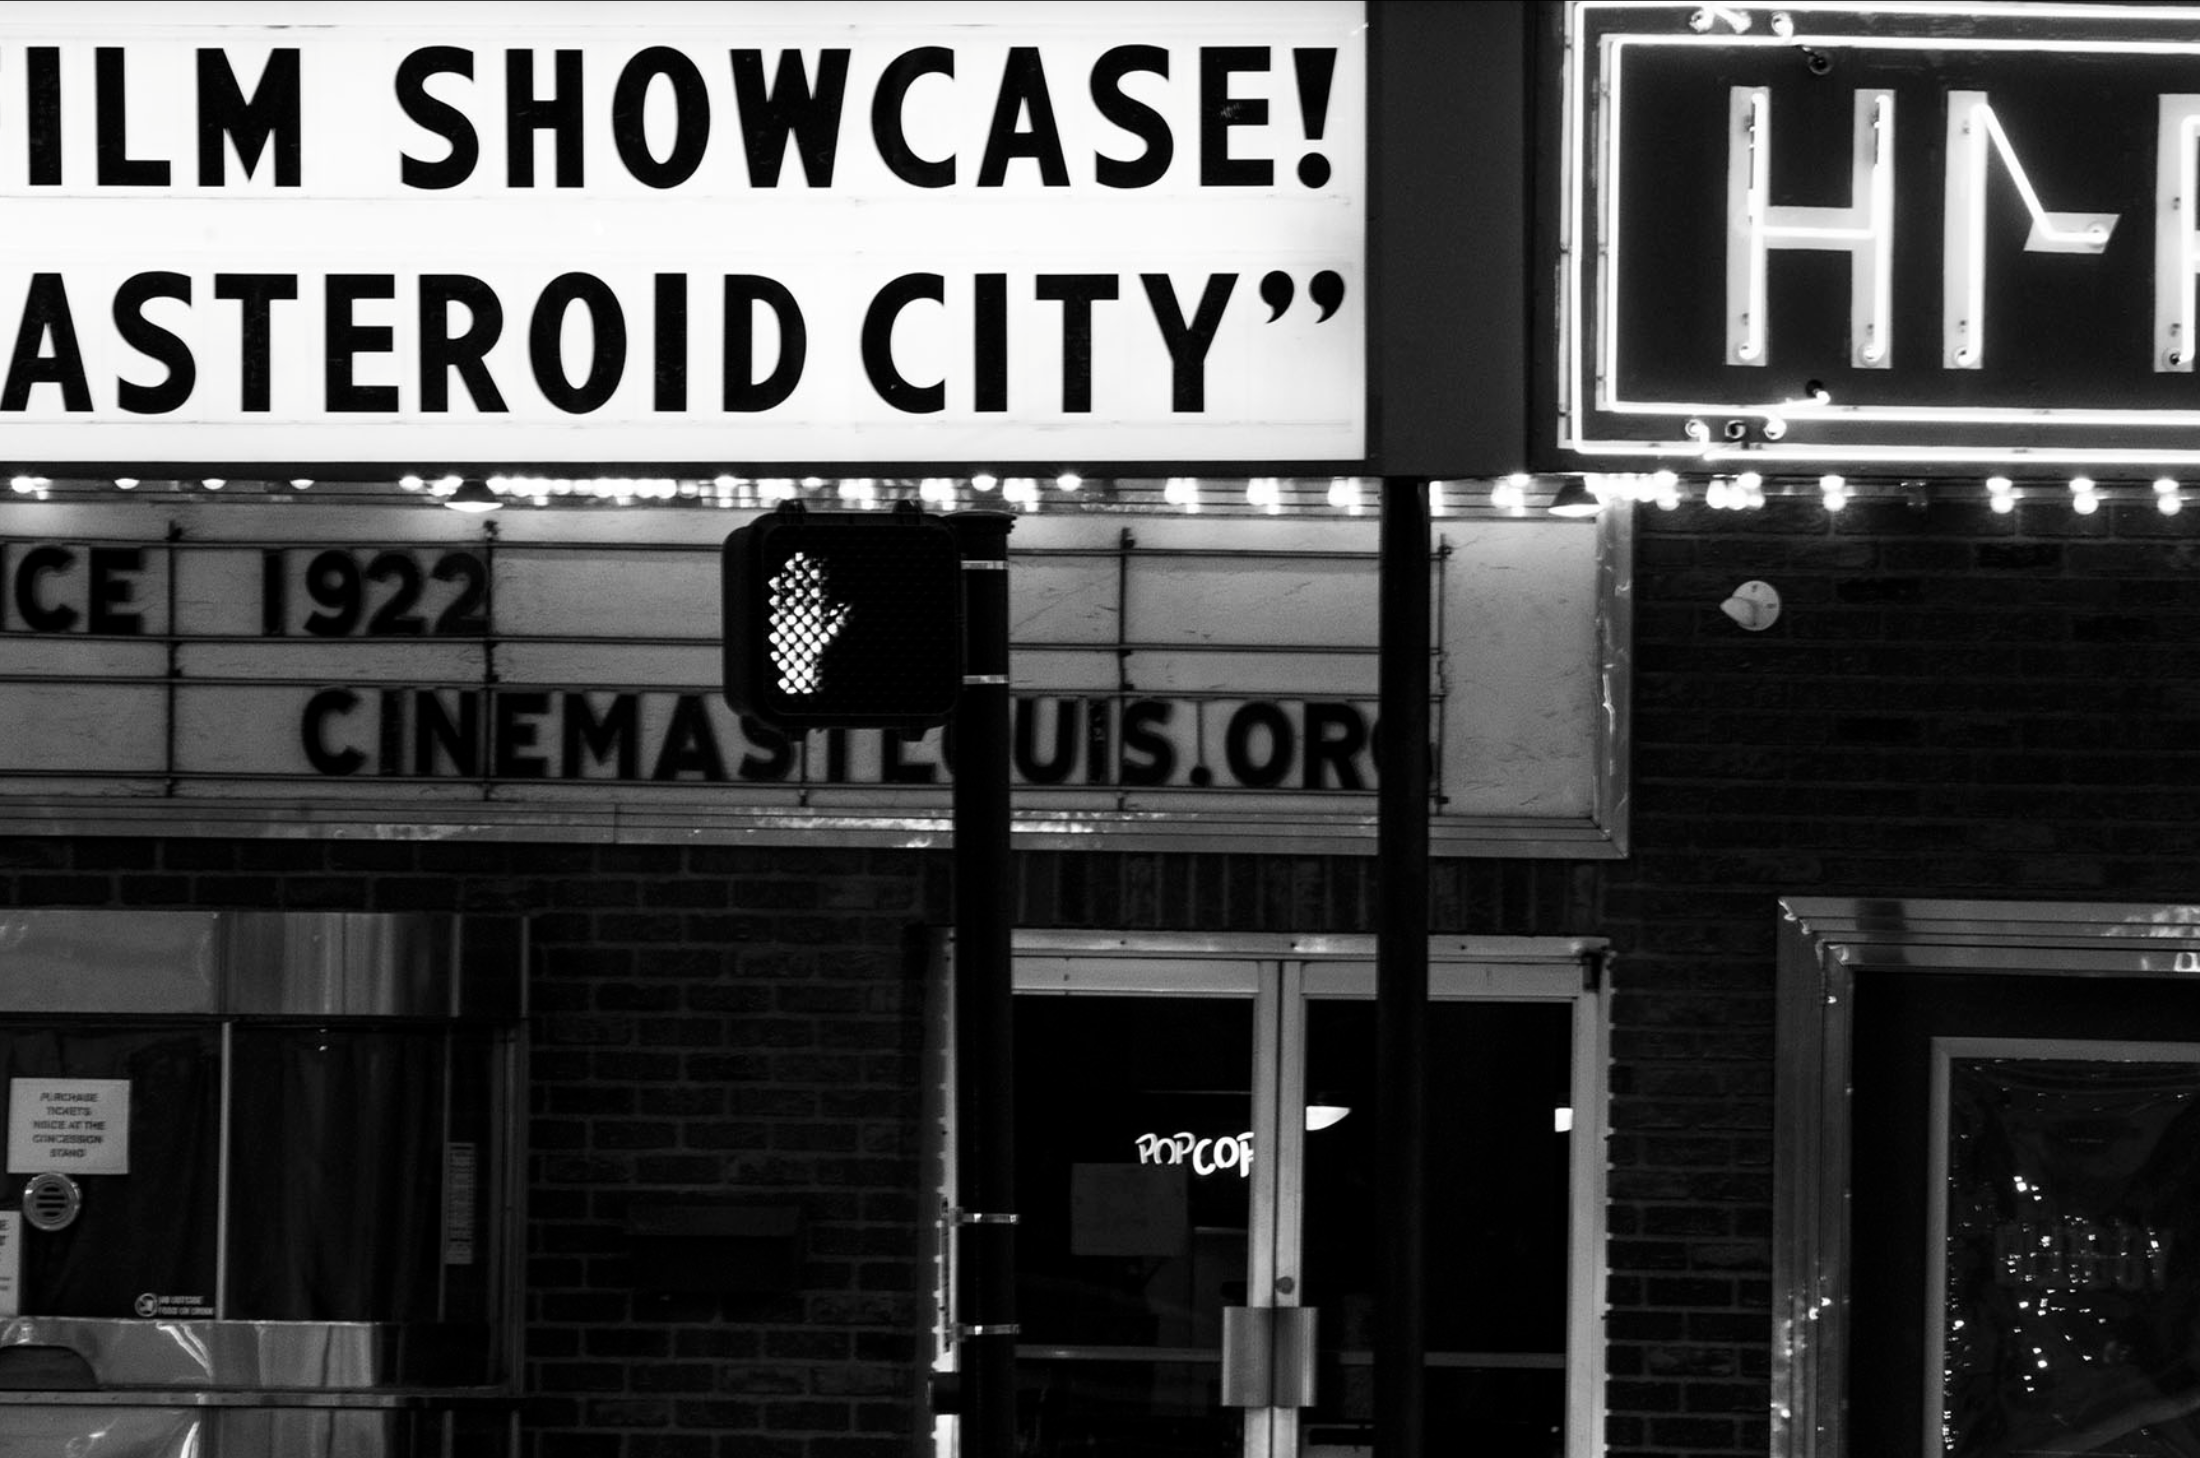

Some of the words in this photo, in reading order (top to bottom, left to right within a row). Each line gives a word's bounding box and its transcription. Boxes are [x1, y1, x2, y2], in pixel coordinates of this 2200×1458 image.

[0, 46, 302, 188] ILM
[394, 44, 1338, 189] SHOWCASE!
[0, 270, 807, 415] ASTEROID
[0, 545, 146, 636] CE
[262, 547, 488, 638] 1922
[302, 686, 1433, 790] CINEMASLUIS.OR
[47, 1106, 92, 1117] TICKETS
